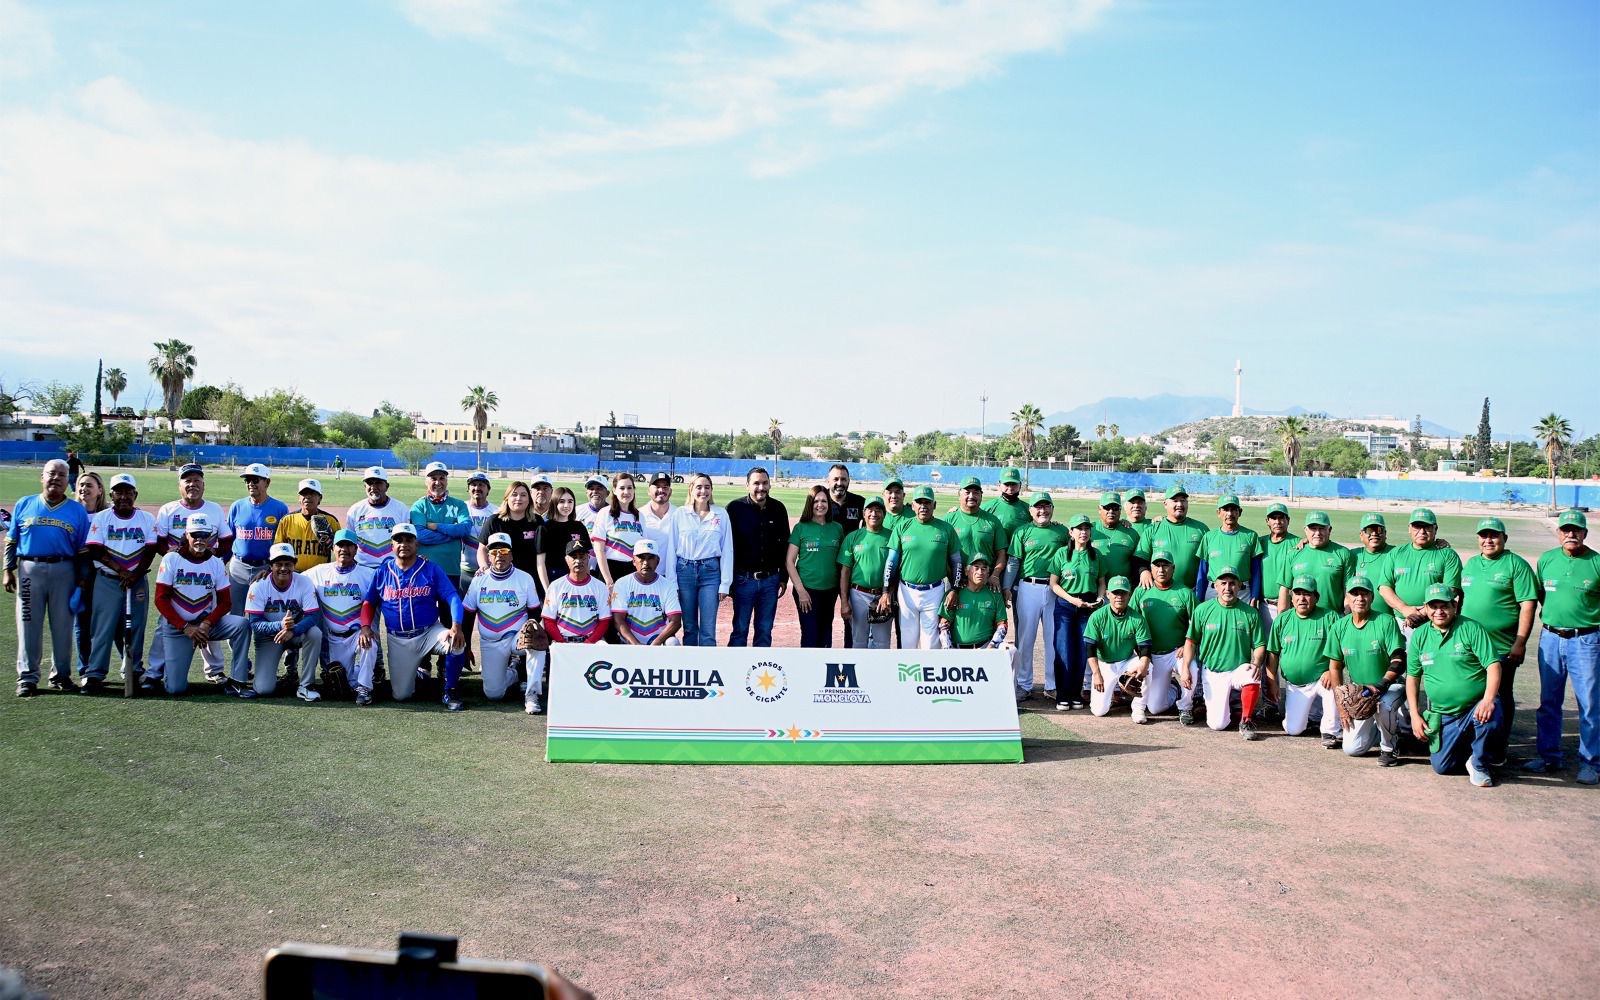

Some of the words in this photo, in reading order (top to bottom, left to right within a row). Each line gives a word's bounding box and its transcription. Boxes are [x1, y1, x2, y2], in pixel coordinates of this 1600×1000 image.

[383, 584, 431, 601] Monclova
[757, 661, 783, 672] PASOS
[897, 663, 989, 683] MEJORA
[584, 660, 725, 692] COAHUILA
[824, 663, 861, 688] M
[655, 688, 701, 699] DELANTE
[745, 686, 756, 697] DE
[755, 686, 788, 703] GIGANTE
[813, 694, 872, 704] MONCLOVA
[916, 685, 974, 696] COAHUILA
